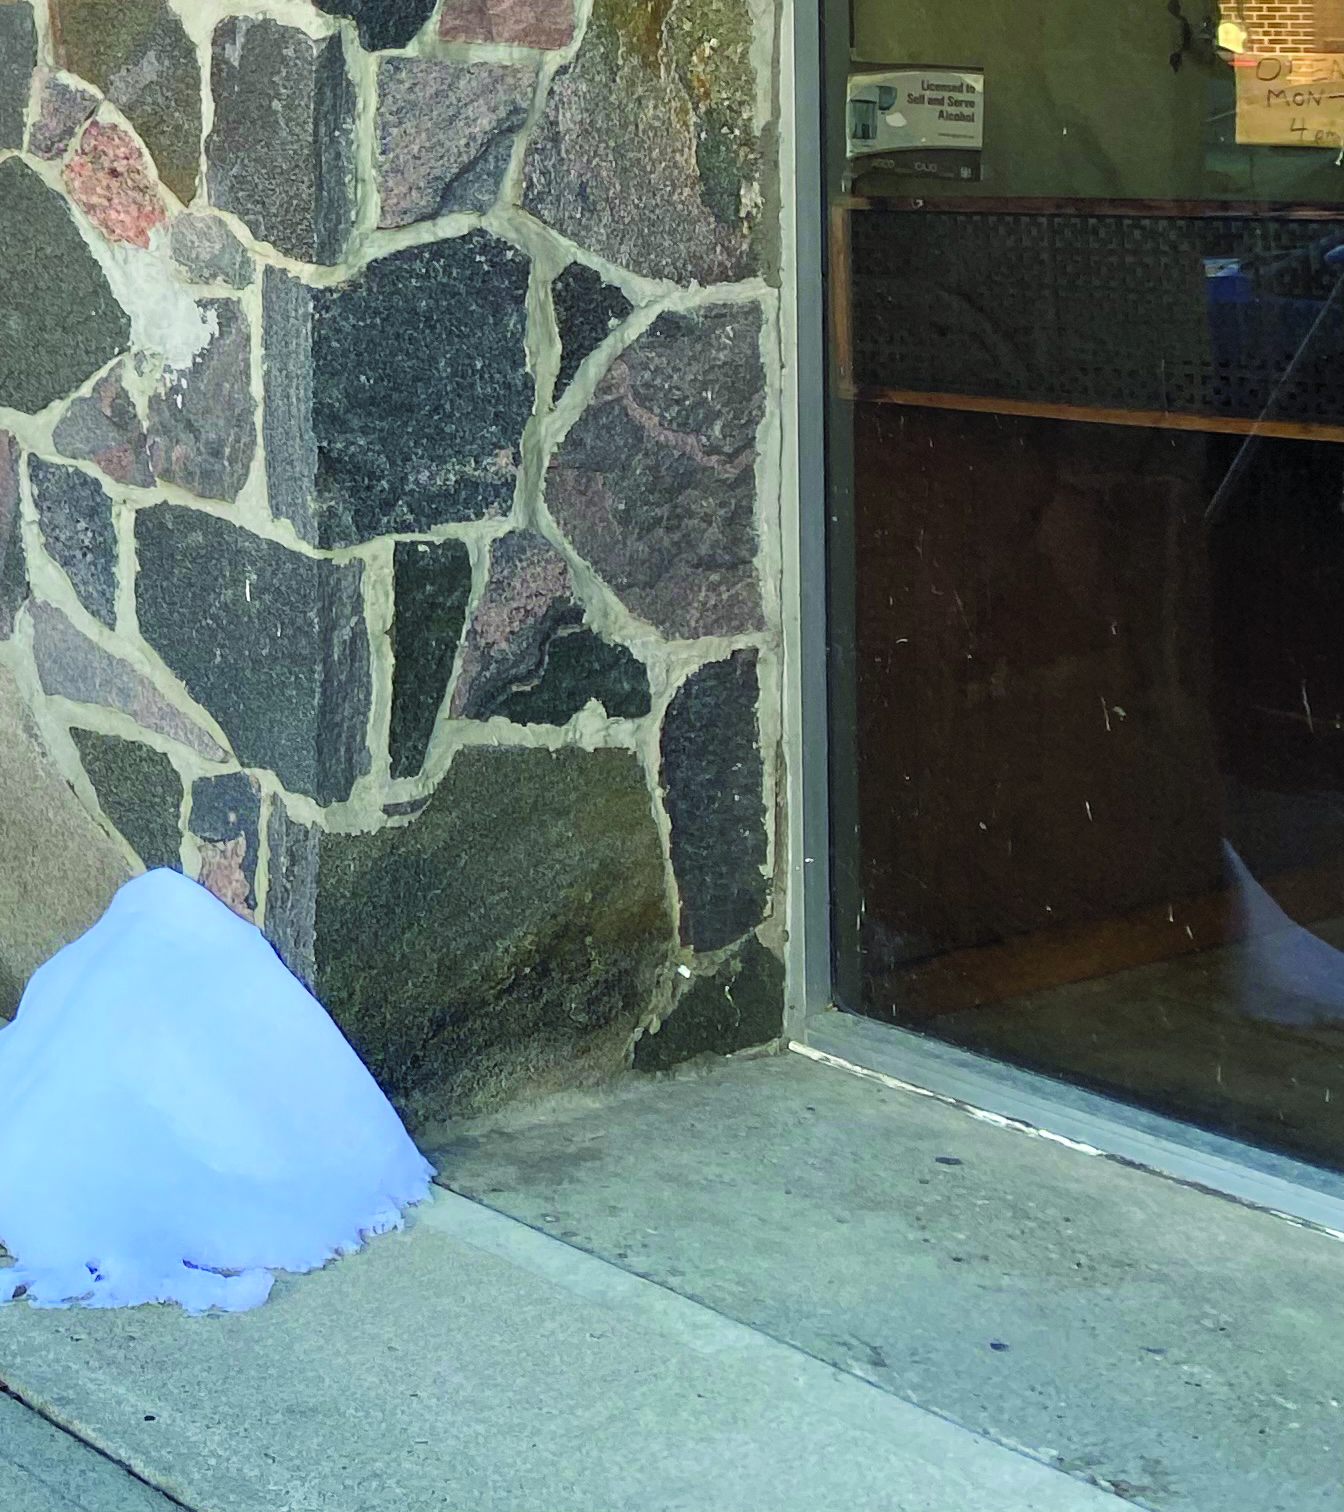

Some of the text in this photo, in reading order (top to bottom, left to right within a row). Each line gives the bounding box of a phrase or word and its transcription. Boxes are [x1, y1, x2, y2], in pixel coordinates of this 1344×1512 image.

[921, 79, 964, 94] Licensed
[907, 92, 975, 108] Sell and Serve
[938, 109, 975, 123] Alcohol
